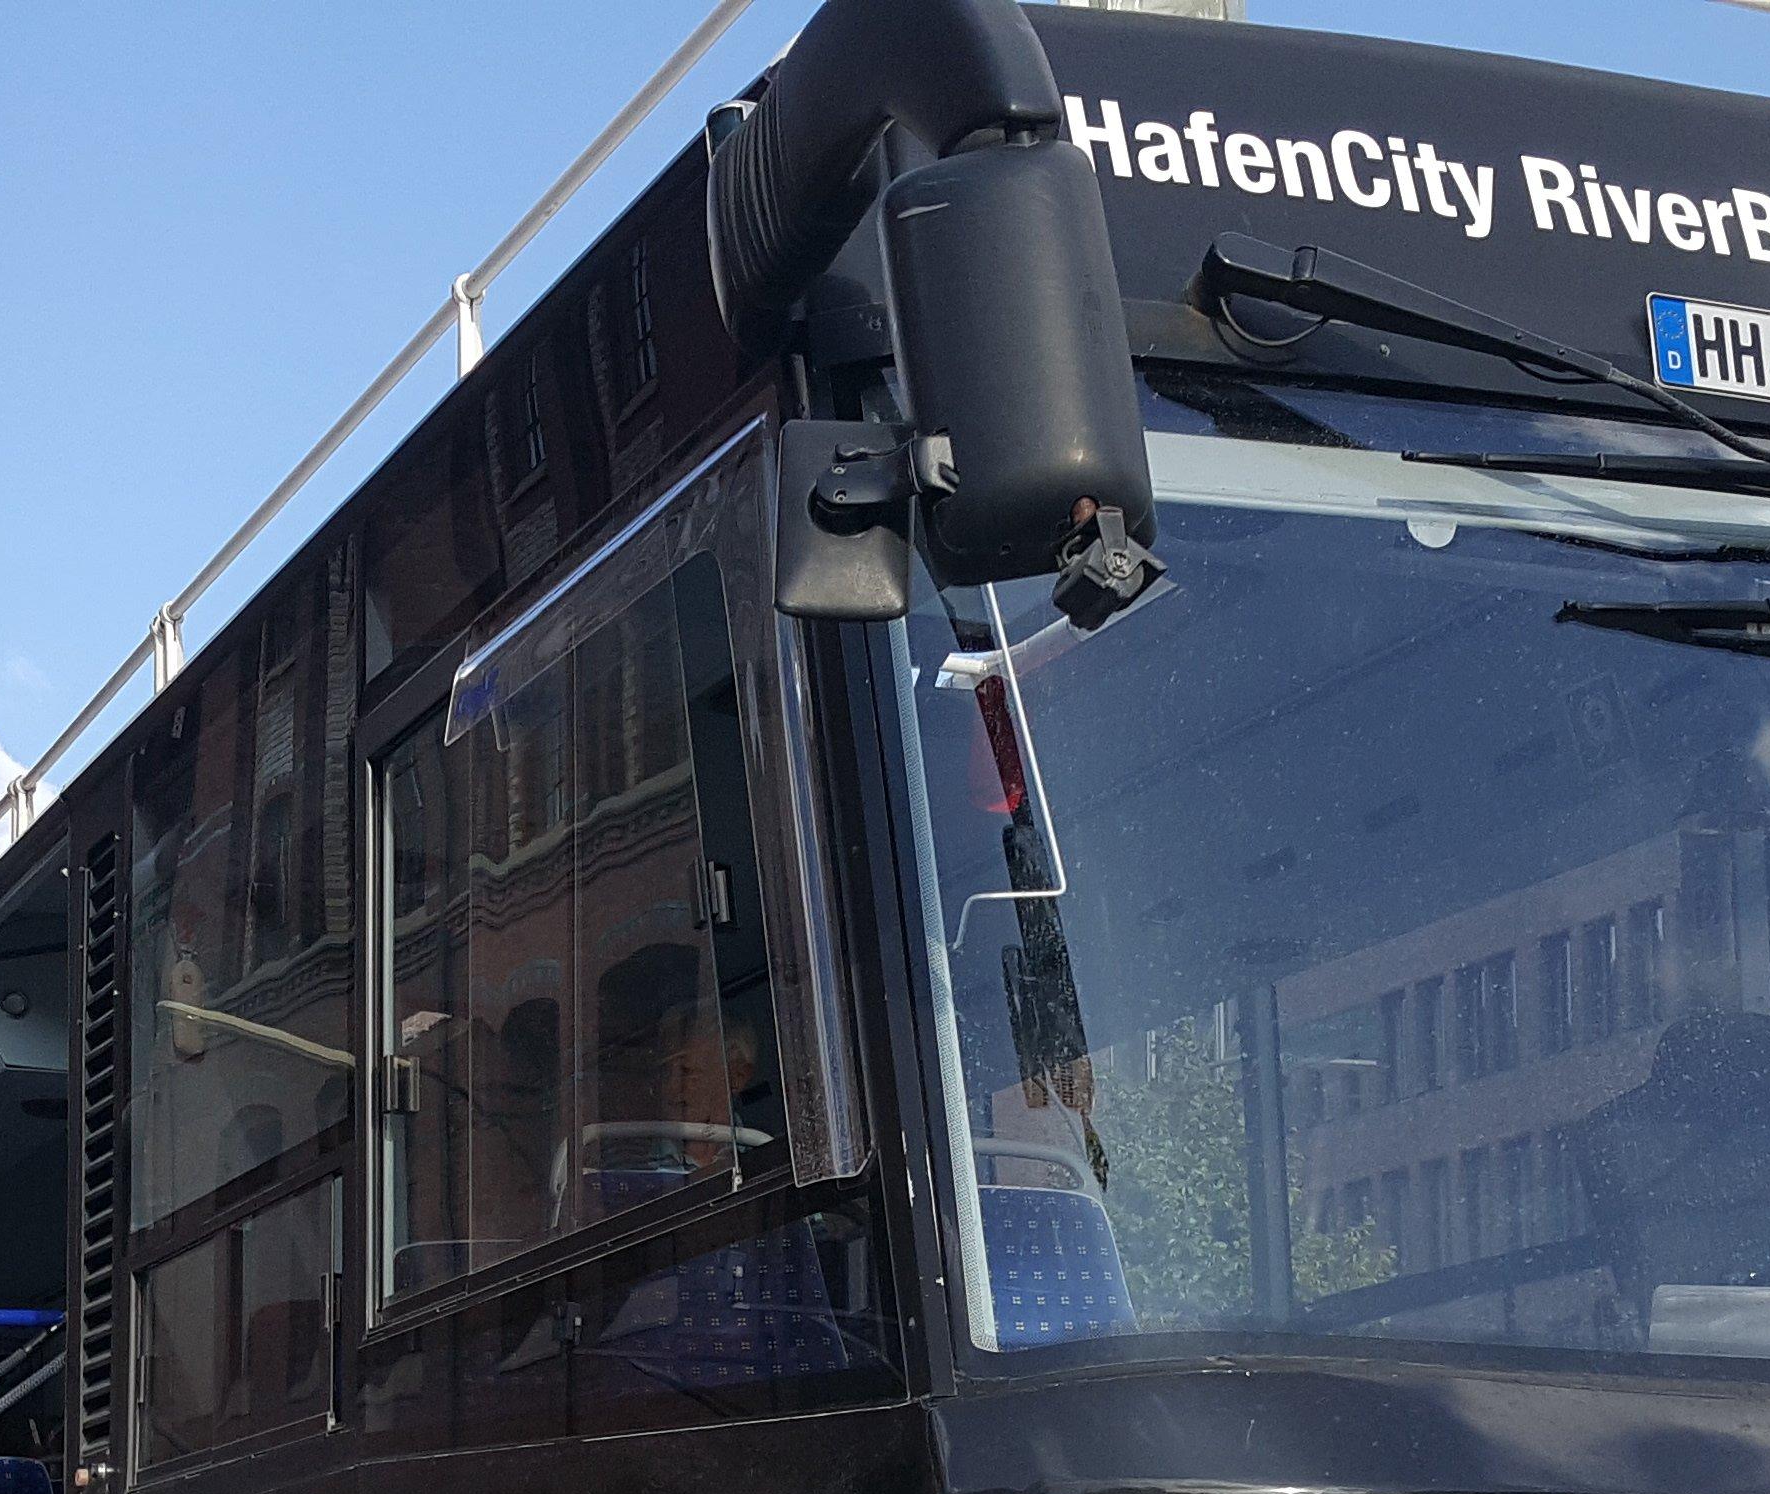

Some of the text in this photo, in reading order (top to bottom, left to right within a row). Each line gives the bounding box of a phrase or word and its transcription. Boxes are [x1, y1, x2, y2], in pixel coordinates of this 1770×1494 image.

[1063, 95, 1494, 238] HafenCity
[1667, 350, 1682, 370] D
[1692, 313, 1766, 388] HH
